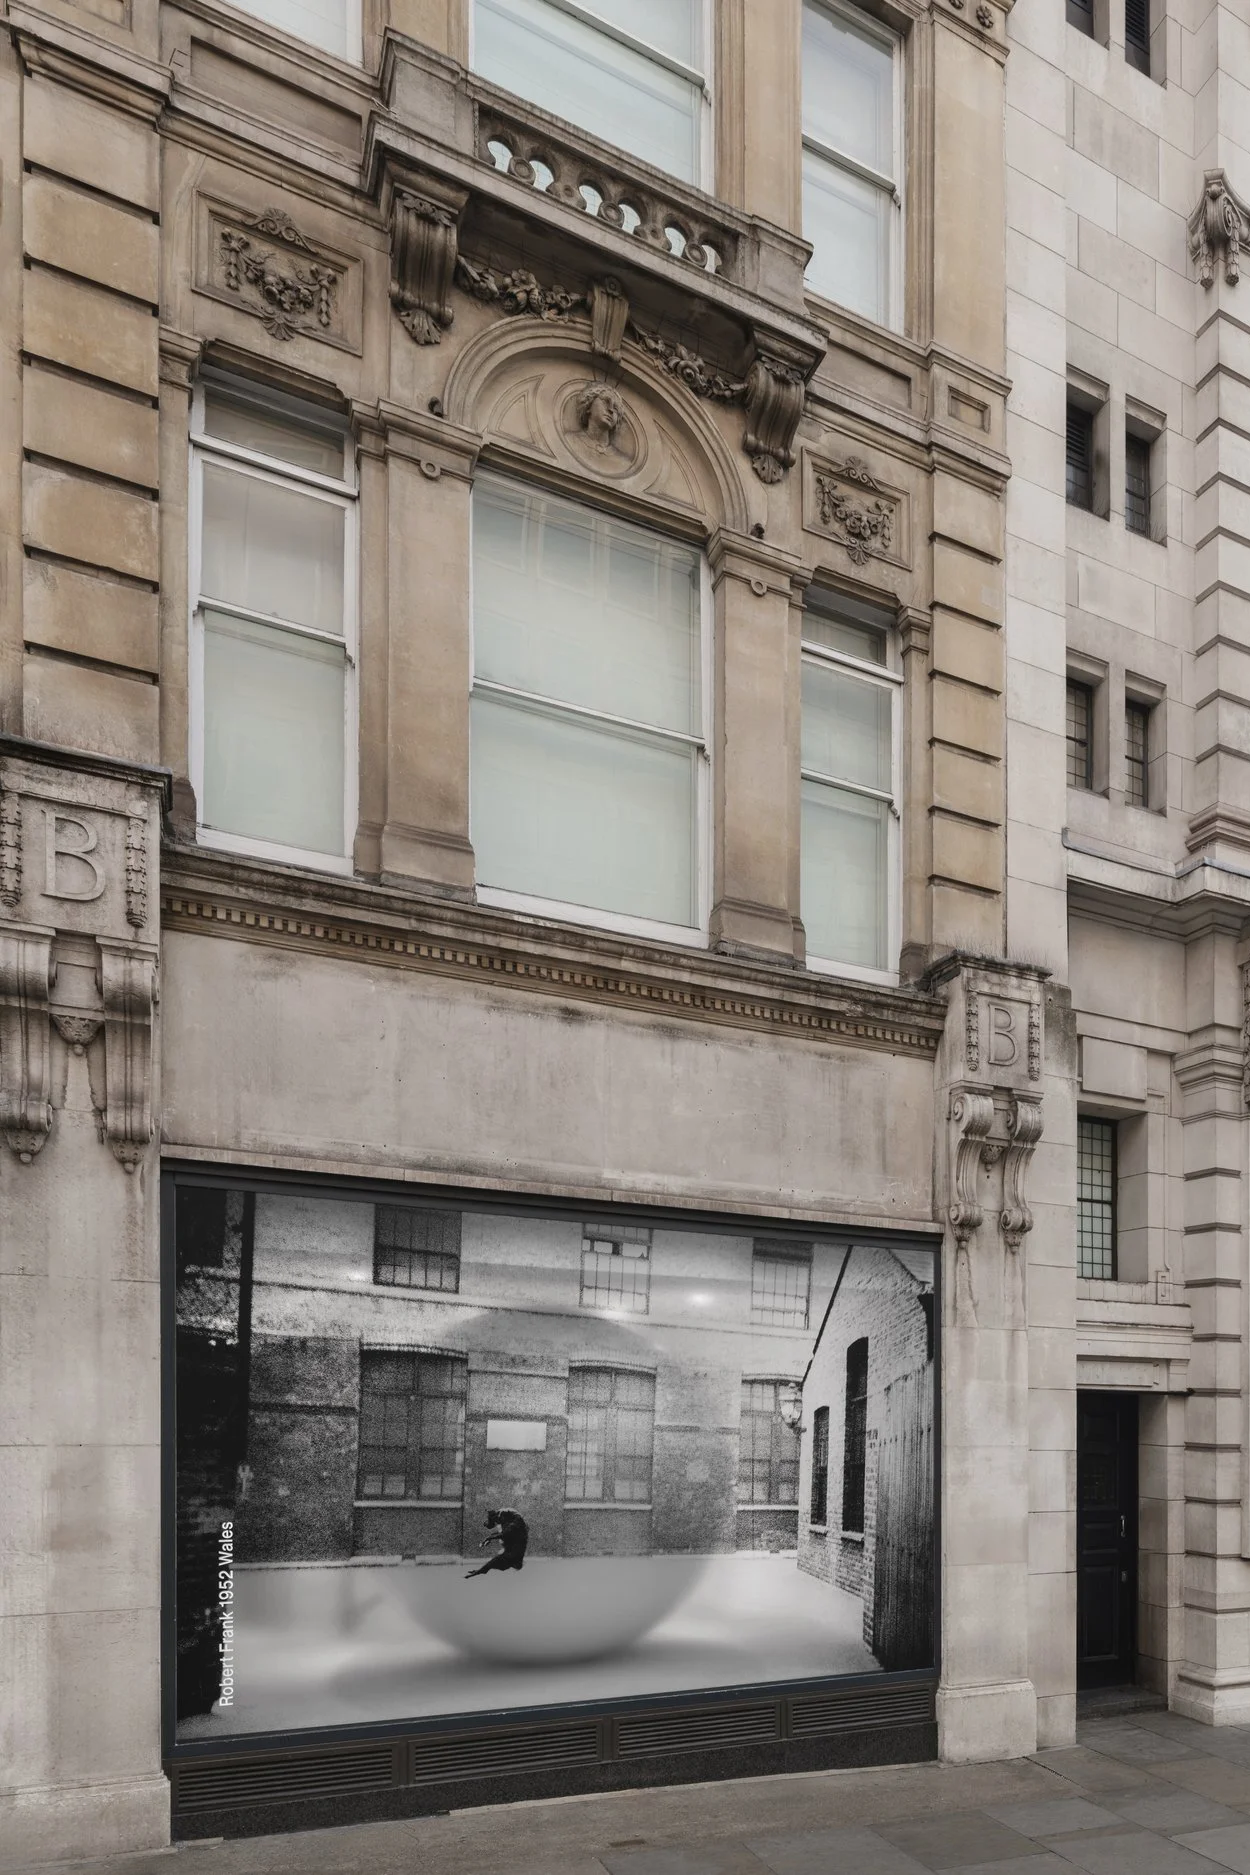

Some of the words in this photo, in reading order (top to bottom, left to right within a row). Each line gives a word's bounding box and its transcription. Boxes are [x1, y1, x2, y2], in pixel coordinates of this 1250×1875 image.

[41, 809, 106, 901] B
[987, 1001, 1020, 1067] B
[218, 1521, 234, 1567] Wales
[218, 1569, 234, 1608] 1952
[218, 1610, 234, 1653] Frank
[218, 1656, 234, 1707] Robert
